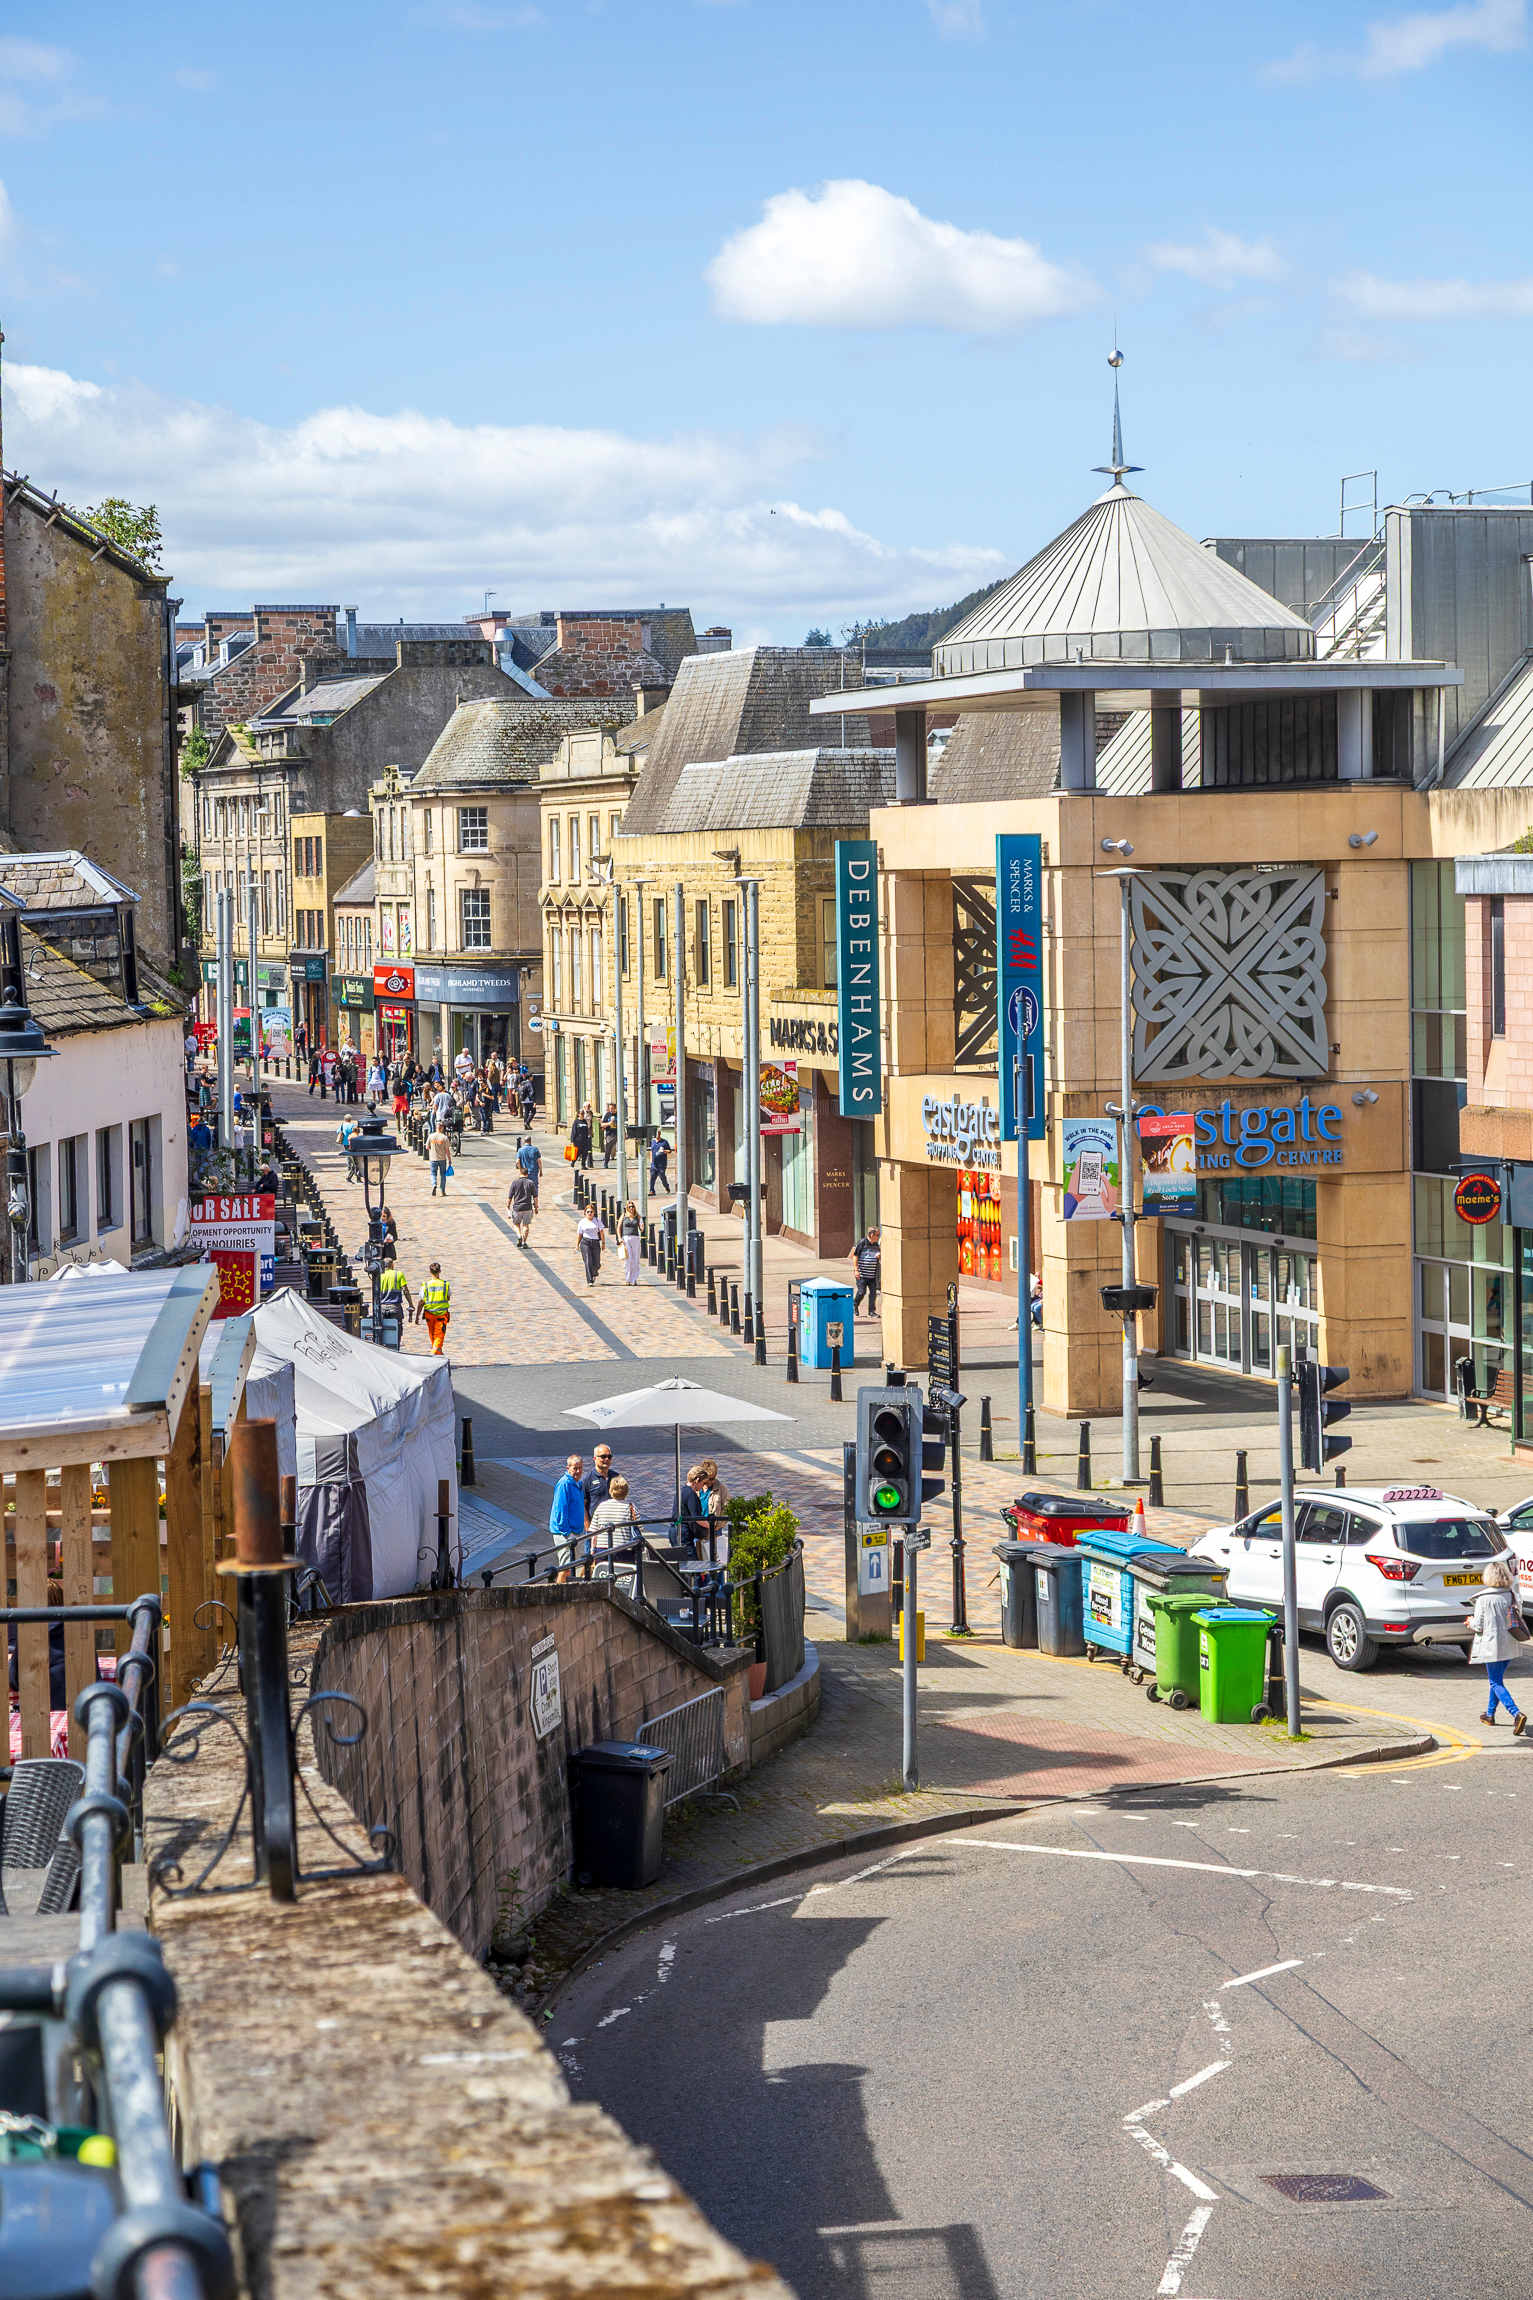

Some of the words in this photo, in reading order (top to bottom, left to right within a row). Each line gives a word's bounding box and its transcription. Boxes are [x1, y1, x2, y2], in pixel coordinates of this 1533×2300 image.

[1009, 859, 1021, 913] SPENCER
[1023, 858, 1033, 902] MARKS
[1023, 904, 1034, 913] &
[479, 979, 511, 987] TWEEDS
[847, 859, 873, 1102] DEBENHAMS
[921, 1094, 999, 1161] eastgate
[1064, 1130, 1081, 1142] WALK
[1080, 1127, 1087, 1135] IN
[1100, 1129, 1116, 1141] PARK
[1137, 1095, 1344, 1167] stgate
[1276, 1149, 1344, 1166] CENTRE
[1160, 1194, 1179, 1202] Story
[1456, 1193, 1500, 1206] Maeme's
[220, 1197, 260, 1220] SALE
[223, 1226, 272, 1236] OPPORTUNITY
[206, 1238, 256, 1249] ENQUIRIES
[1389, 1488, 1438, 1501] 222222
